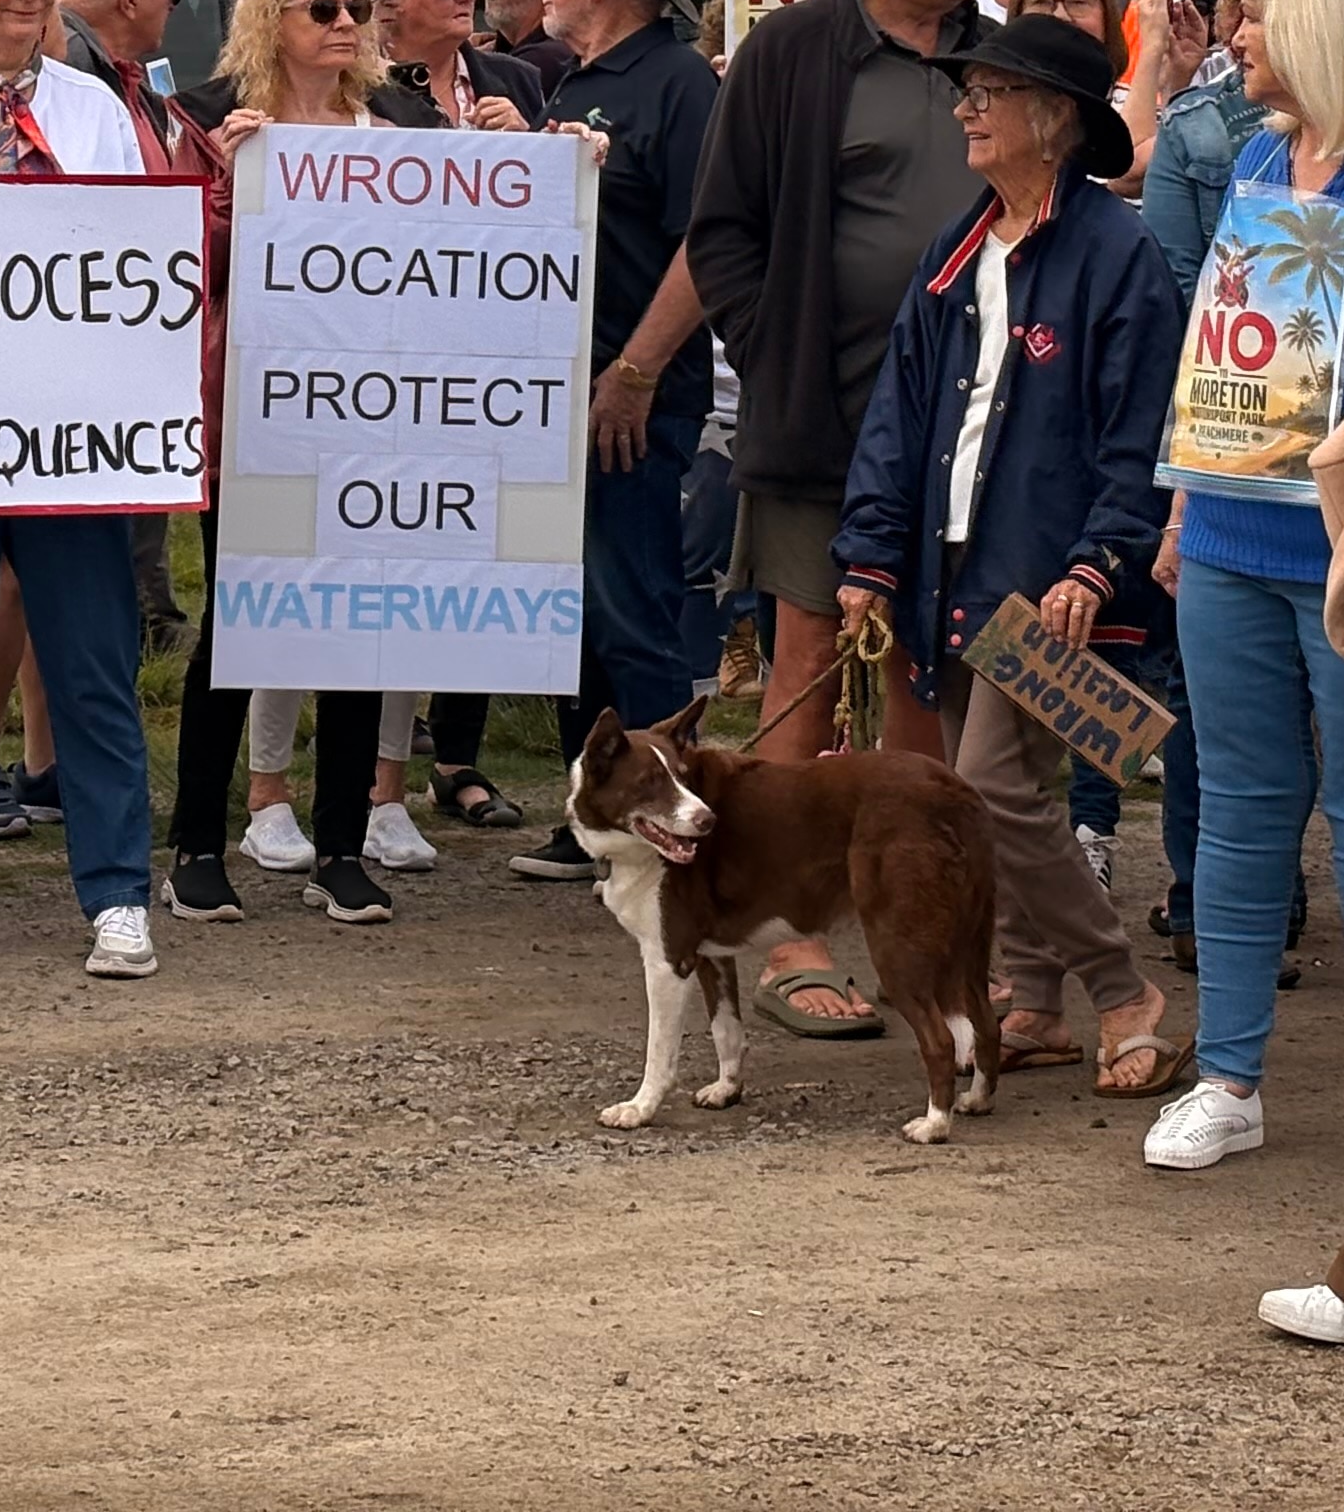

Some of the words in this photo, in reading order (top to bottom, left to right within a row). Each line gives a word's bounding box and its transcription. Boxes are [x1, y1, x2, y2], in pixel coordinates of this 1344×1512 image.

[278, 152, 532, 208] WRONG
[264, 242, 578, 302] LOCATION
[1194, 310, 1277, 372] NO
[262, 370, 565, 427] PROTECT
[1190, 377, 1267, 412] MORETON
[1239, 411, 1266, 426] PARK
[338, 480, 477, 532] OUR
[216, 580, 581, 635] WATERWAYS
[993, 653, 1122, 766] WRONG
